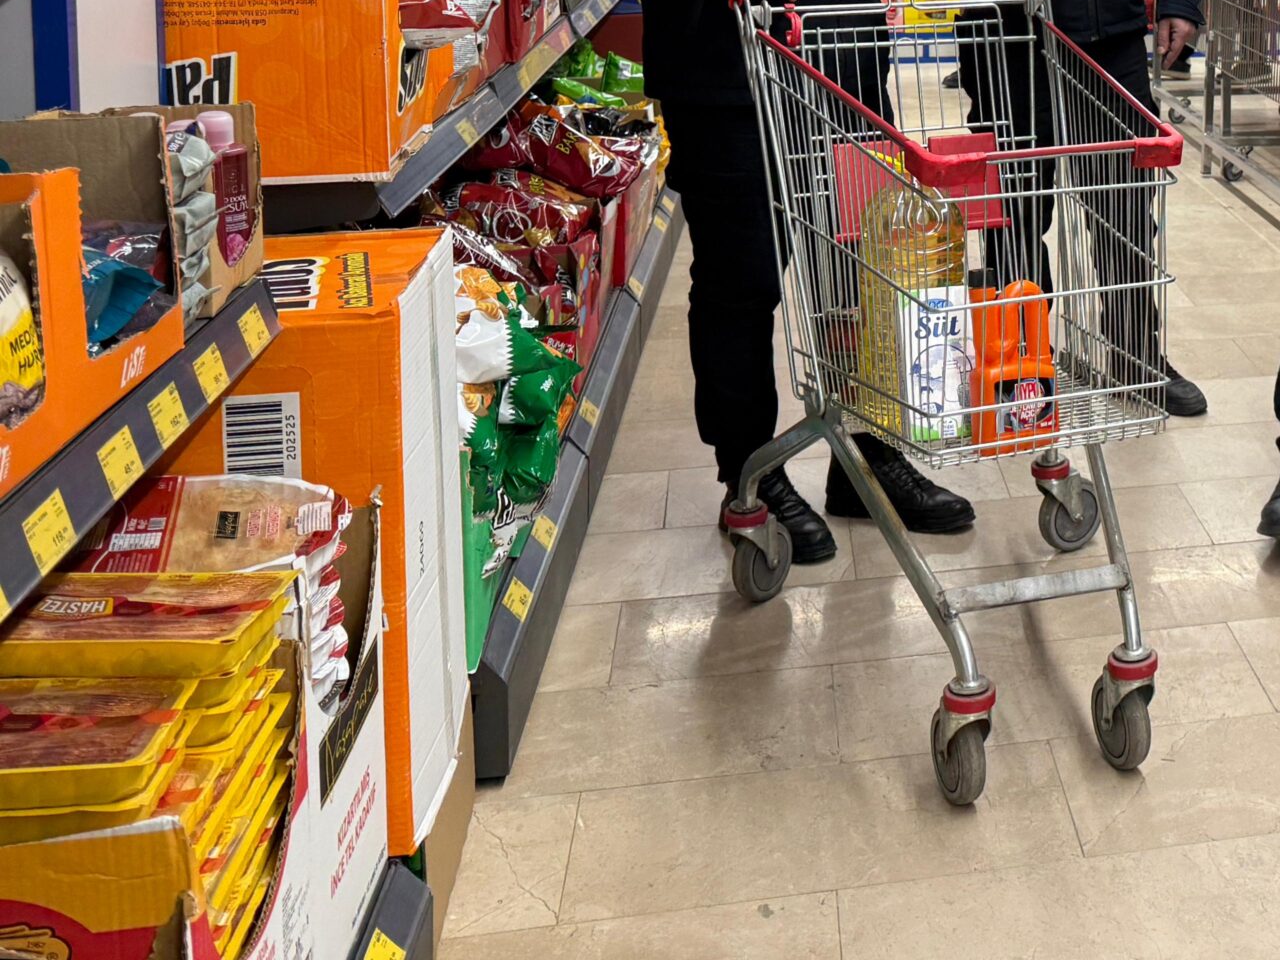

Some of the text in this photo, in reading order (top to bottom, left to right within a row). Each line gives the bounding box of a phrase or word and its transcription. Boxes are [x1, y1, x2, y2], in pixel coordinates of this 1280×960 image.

[915, 315, 961, 340] Süt
[285, 414, 296, 461] 202525
[40, 599, 106, 614] HASTEL
